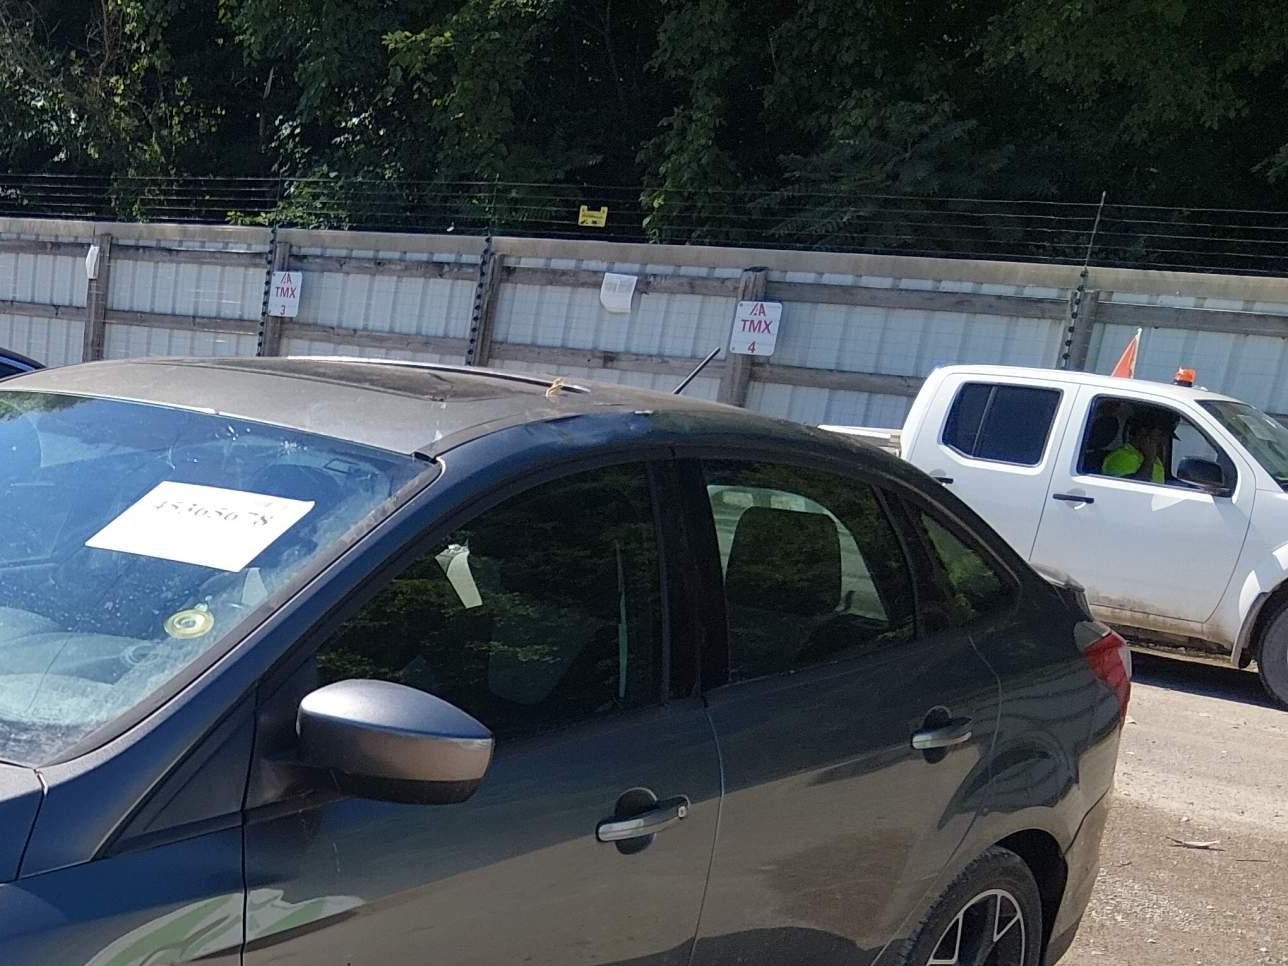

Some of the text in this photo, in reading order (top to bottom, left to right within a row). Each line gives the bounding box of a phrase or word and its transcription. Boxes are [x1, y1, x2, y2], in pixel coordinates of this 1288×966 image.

[275, 286, 297, 299] TMX
[280, 304, 286, 315] 3
[741, 319, 773, 335] TMX
[747, 341, 756, 354] 4
